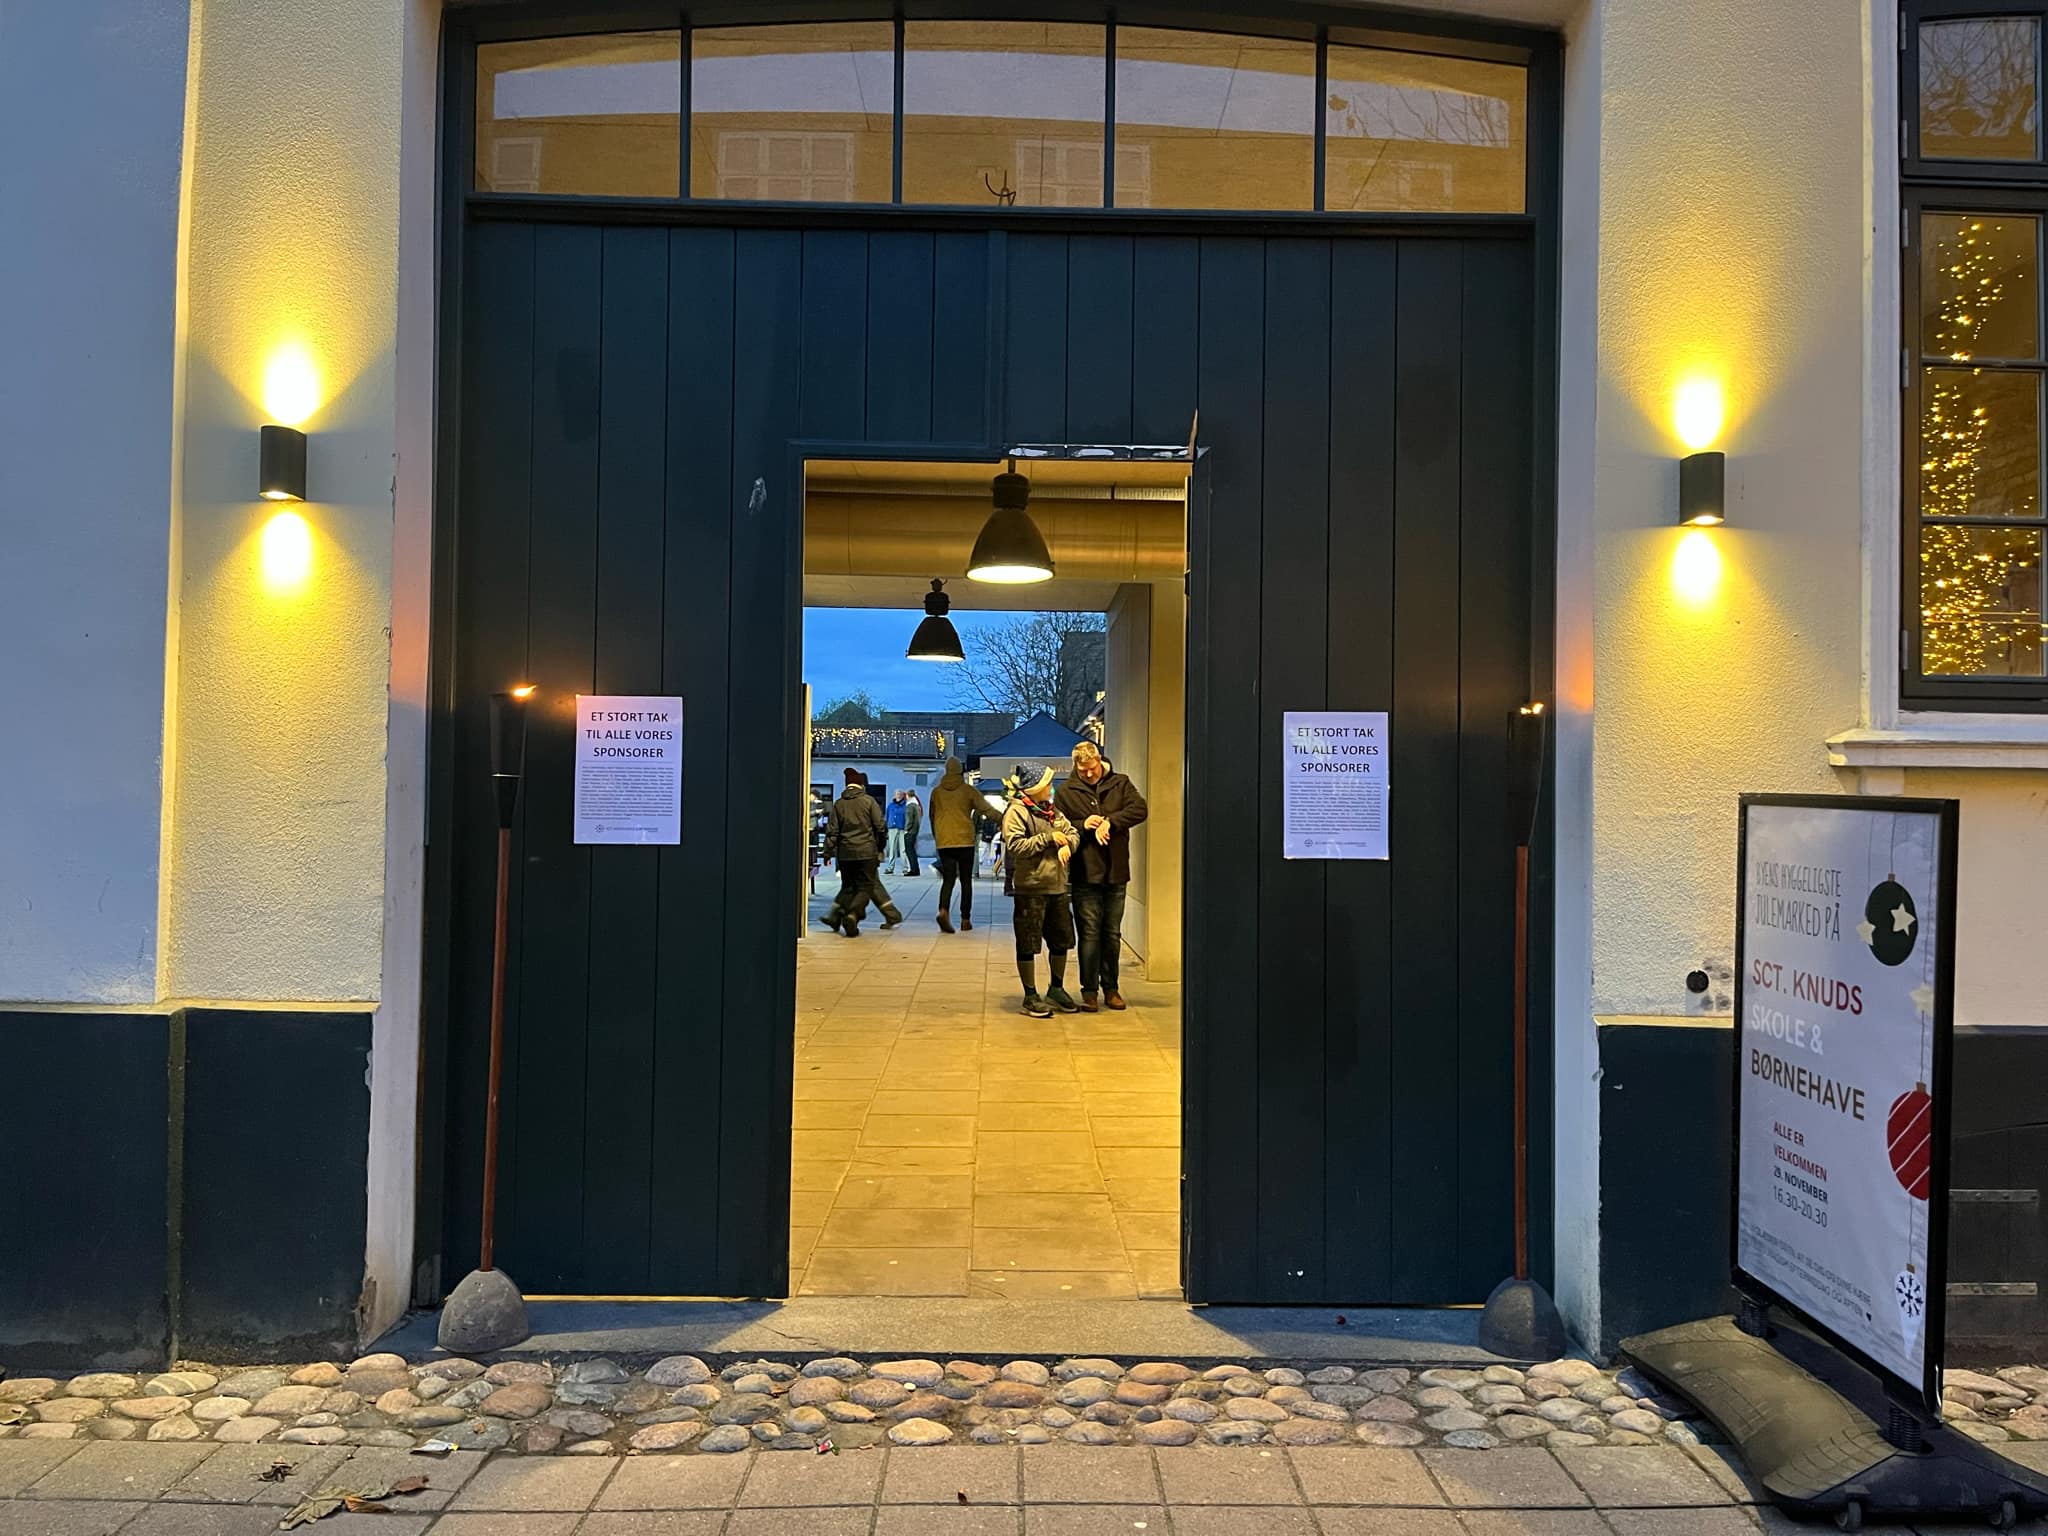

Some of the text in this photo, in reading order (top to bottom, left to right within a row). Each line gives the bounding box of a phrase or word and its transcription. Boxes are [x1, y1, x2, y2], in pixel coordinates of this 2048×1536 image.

[591, 711, 669, 723] ET STORT TAK
[1297, 727, 1375, 738] ET STORT TAK
[585, 729, 673, 741] TIL ALLE VORES
[593, 746, 664, 758] SPONSORER
[1292, 745, 1379, 756] TIL ALLE VORES
[1300, 762, 1371, 773] SPONSORER
[1781, 864, 1842, 898] HYGGELIGSTE
[1755, 893, 1841, 943] JULEMARKED PÅ
[1752, 958, 1863, 1016] SCT. KNUDS
[1751, 1004, 1824, 1056] SKOLE &
[1751, 1048, 1865, 1121] BØRNEHAVE
[1773, 1121, 1805, 1148] ALLE ER
[1773, 1143, 1828, 1183] VELKOMMEN
[1784, 1171, 1829, 1205] NOVEMBER
[1773, 1184, 1828, 1229] 16.30-20.30
